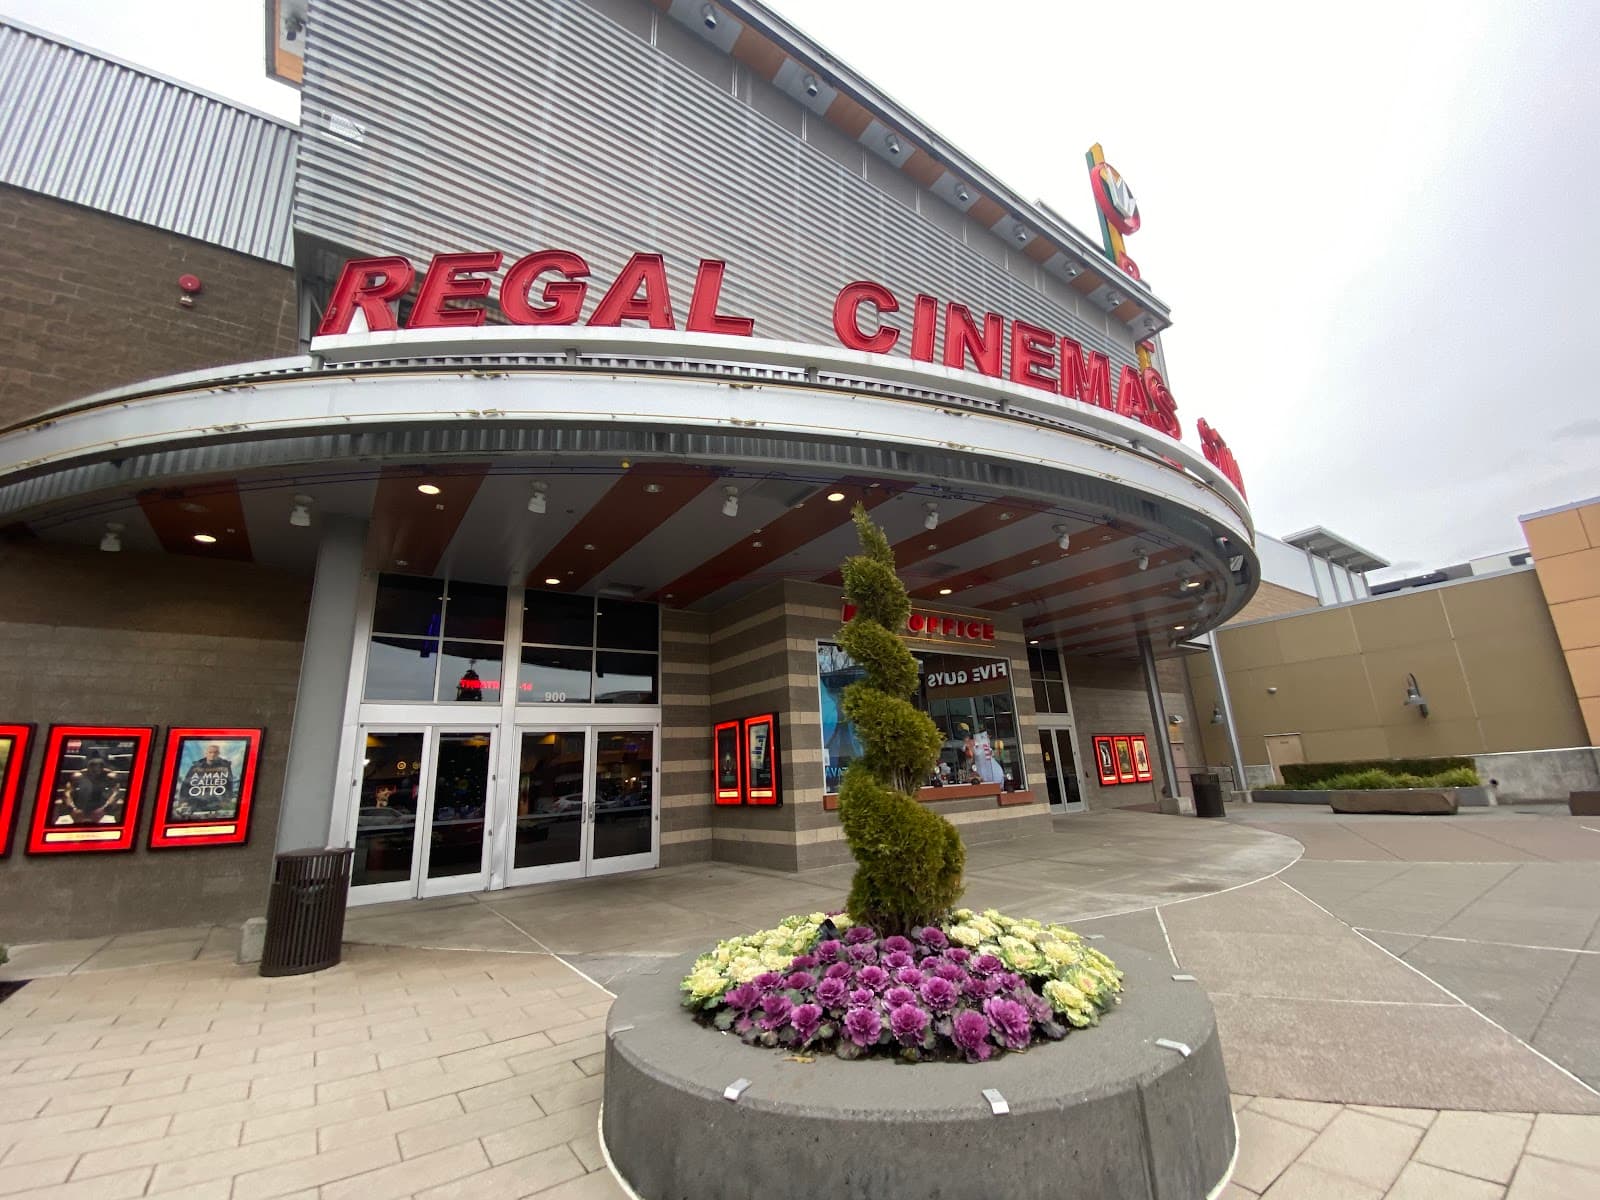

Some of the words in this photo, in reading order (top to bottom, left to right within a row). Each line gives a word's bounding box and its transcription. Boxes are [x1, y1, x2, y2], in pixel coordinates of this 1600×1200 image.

[318, 249, 756, 337] REGAL
[833, 280, 1182, 441] CINEMAS
[908, 614, 995, 641] OFFICE
[544, 691, 566, 703] 900
[190, 778, 227, 786] CALLED
[189, 785, 226, 796] OTTO
